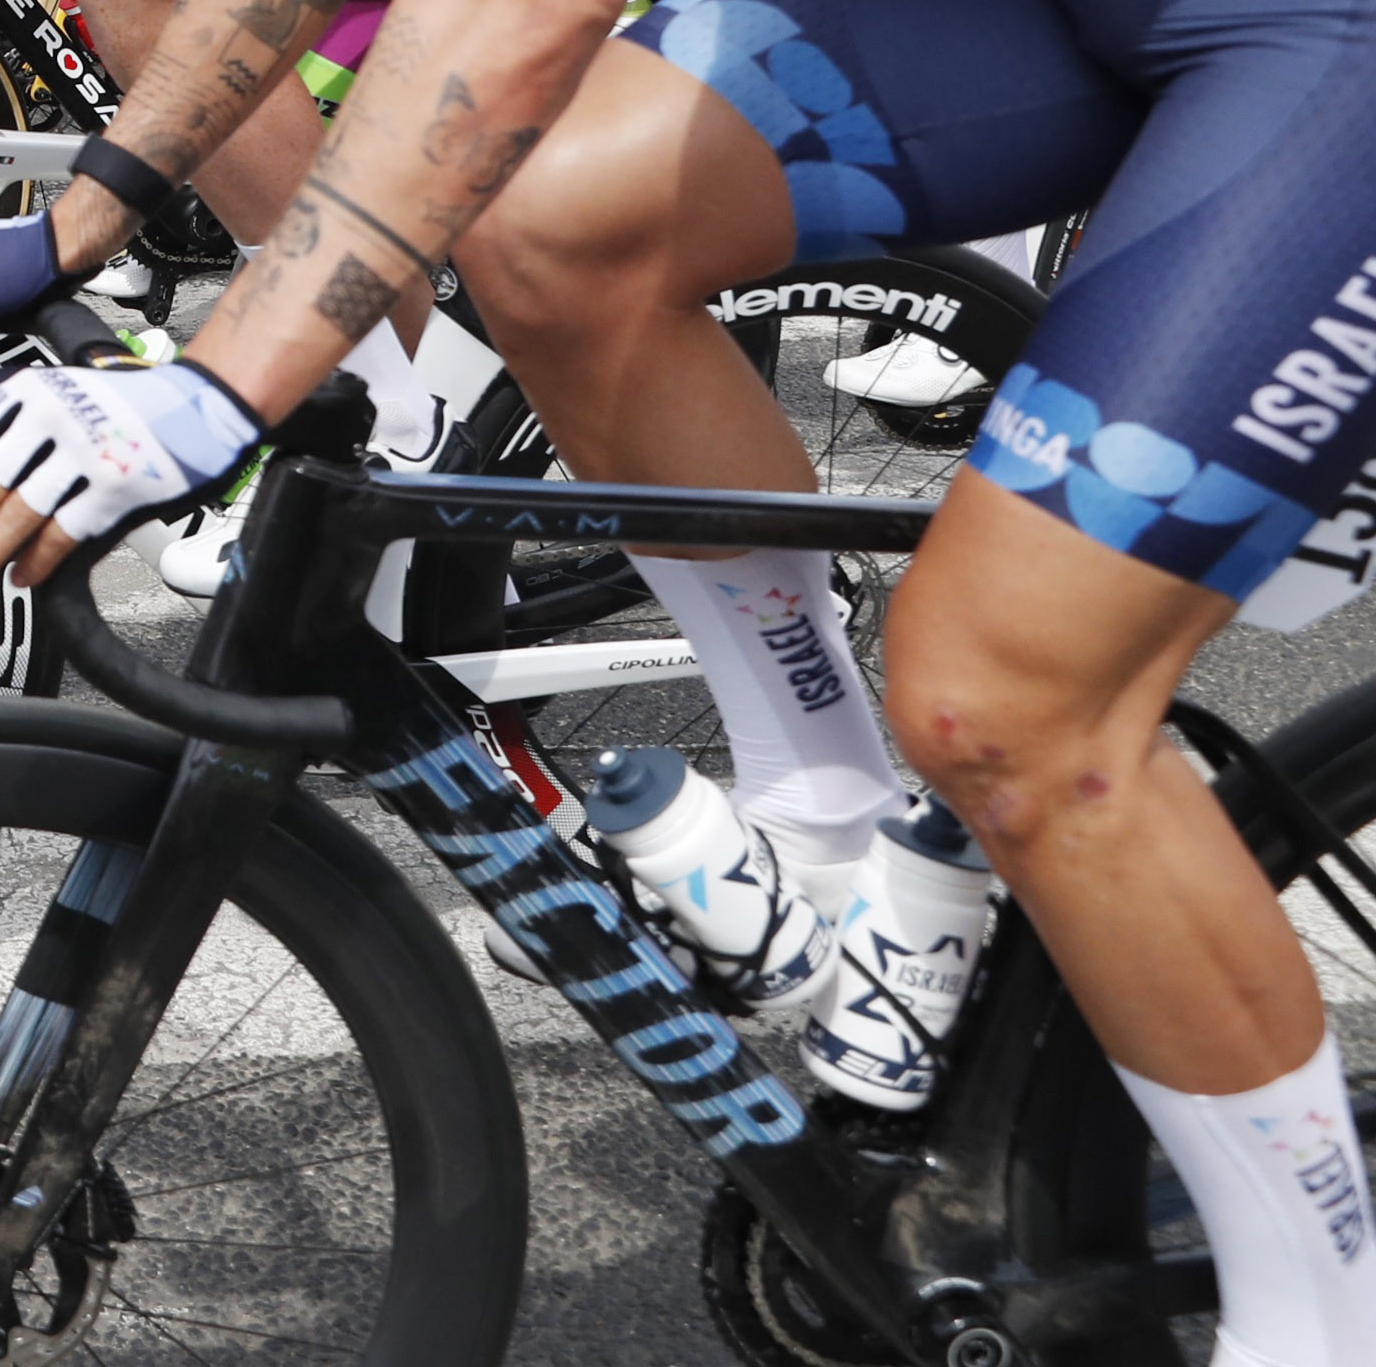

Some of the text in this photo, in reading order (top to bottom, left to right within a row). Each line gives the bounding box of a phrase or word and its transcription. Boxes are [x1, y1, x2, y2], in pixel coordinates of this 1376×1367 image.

[33, 18, 122, 128] ROSA
[1231, 254, 1376, 465] ISRAE
[761, 610, 847, 714] ISRAEL
